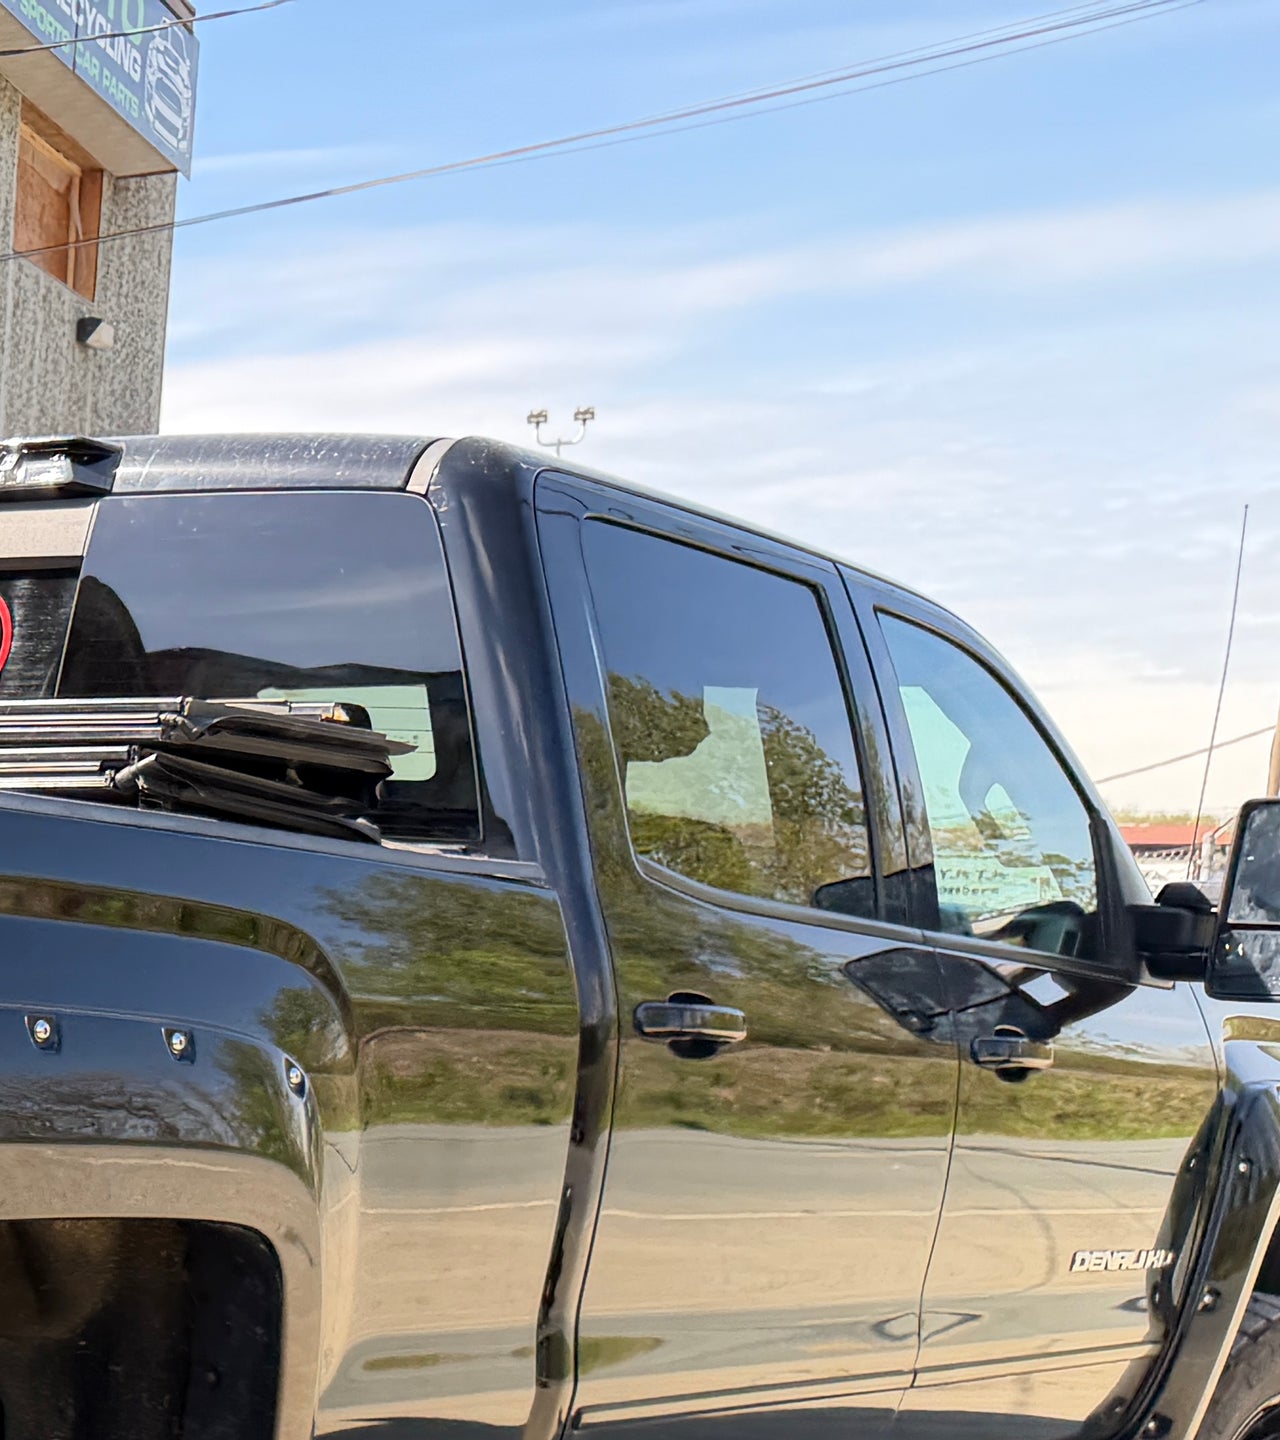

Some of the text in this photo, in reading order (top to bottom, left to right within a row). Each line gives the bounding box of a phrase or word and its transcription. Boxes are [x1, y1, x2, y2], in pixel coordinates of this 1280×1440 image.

[57, 0, 142, 83] ECYCLING
[75, 42, 100, 84] CAR
[102, 66, 140, 119] PARTS
